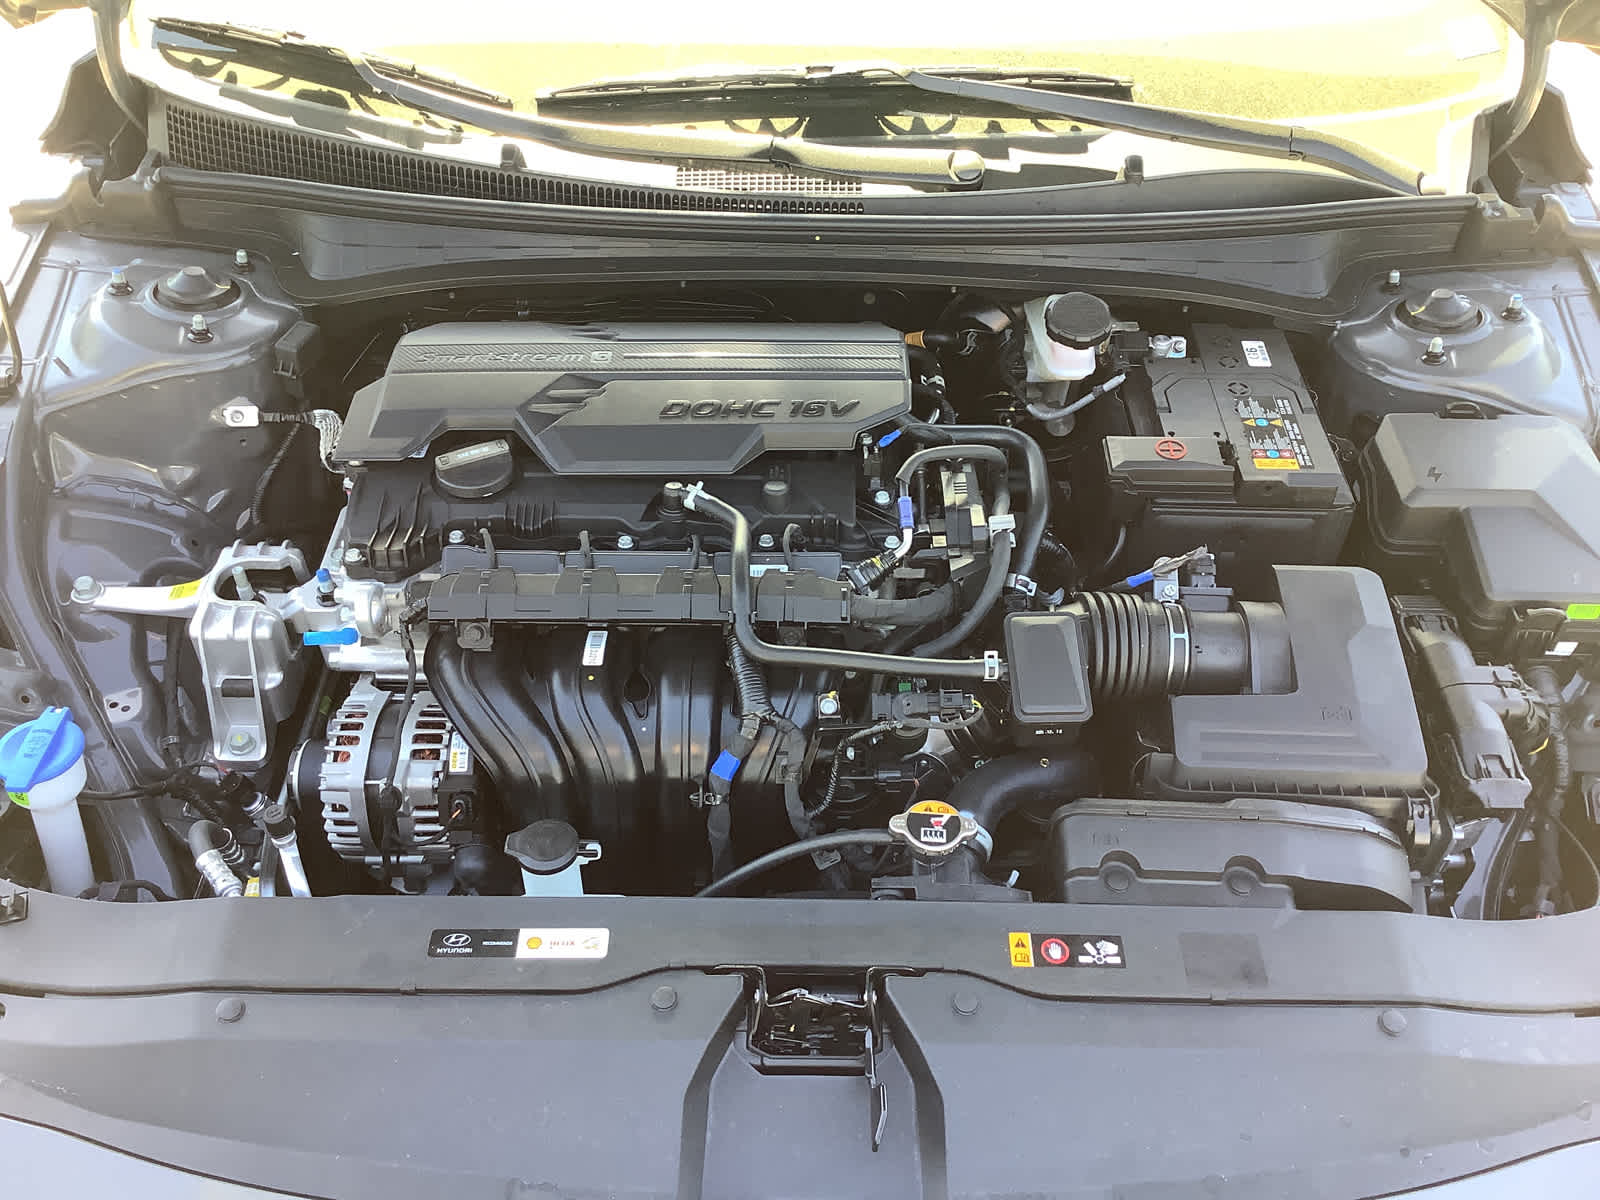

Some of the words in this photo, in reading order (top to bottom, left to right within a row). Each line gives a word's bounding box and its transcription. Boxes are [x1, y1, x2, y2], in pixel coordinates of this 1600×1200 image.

[415, 351, 586, 363] Smartstream
[659, 399, 781, 418] DOHC
[789, 399, 861, 418] 16V
